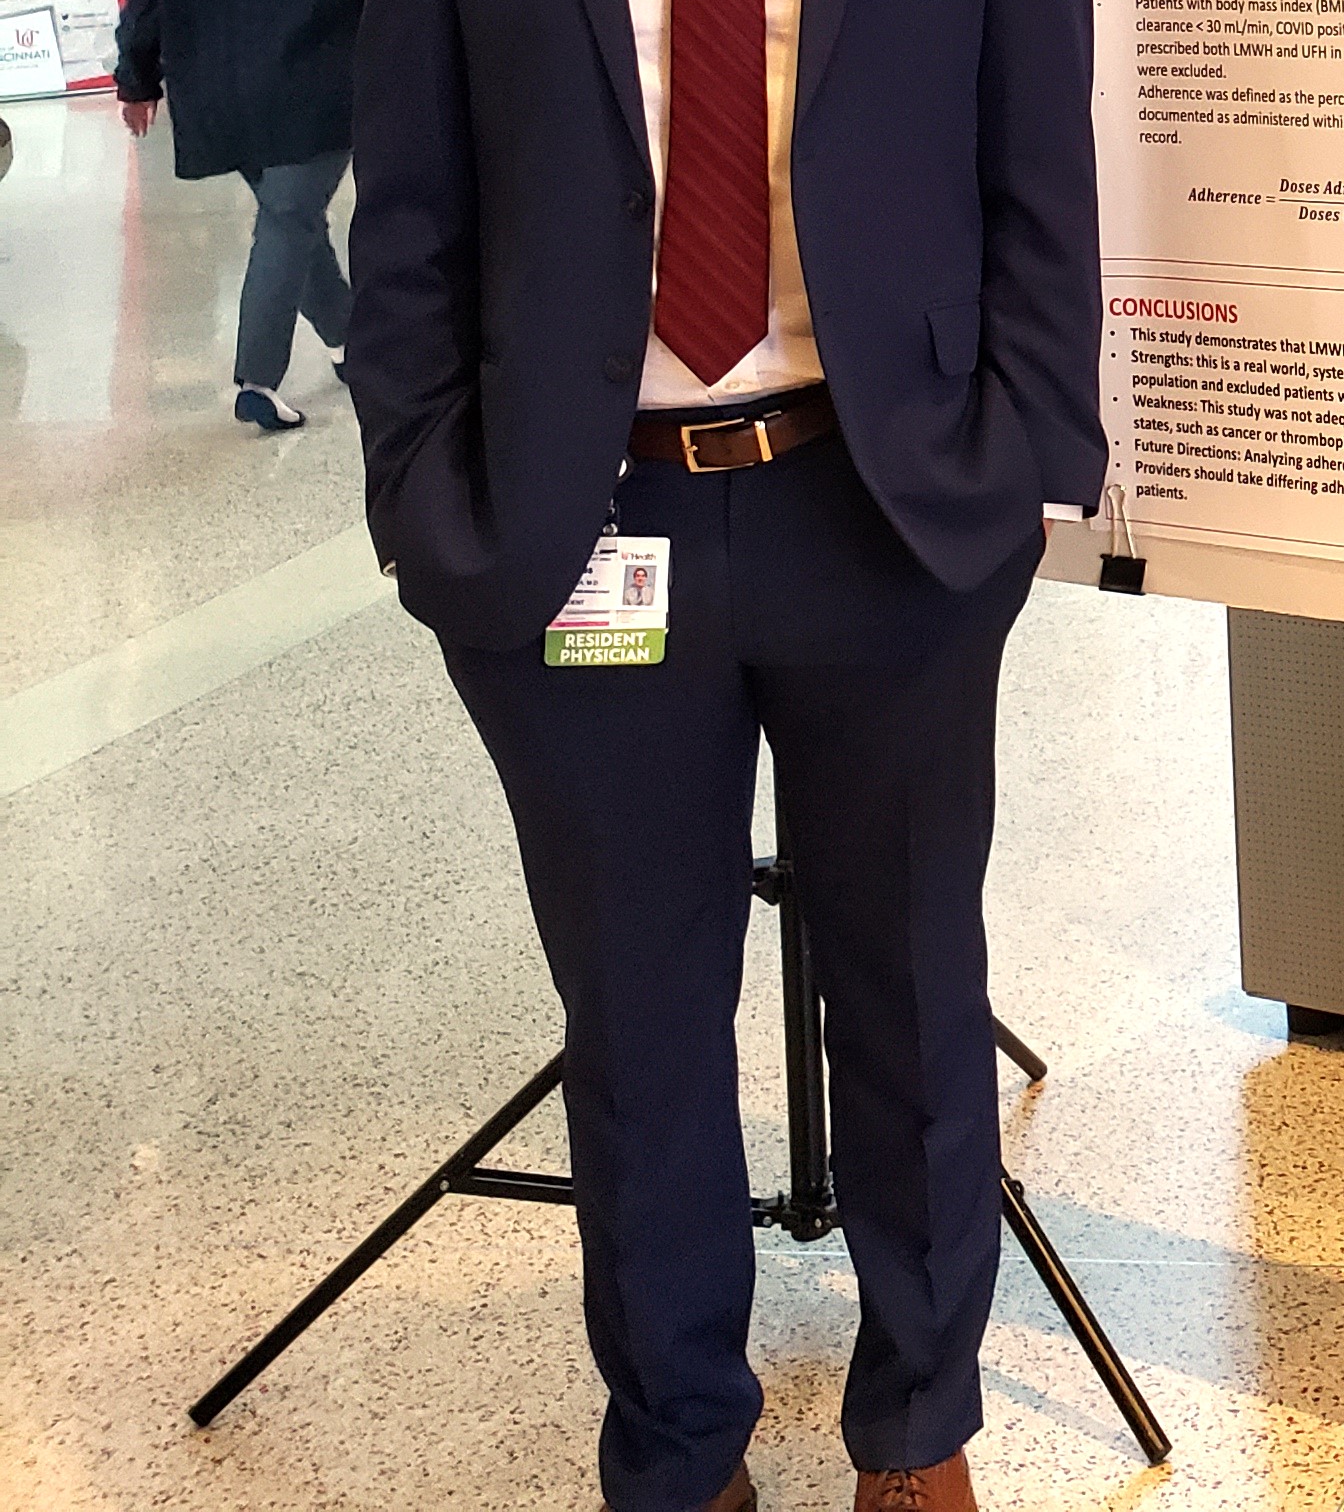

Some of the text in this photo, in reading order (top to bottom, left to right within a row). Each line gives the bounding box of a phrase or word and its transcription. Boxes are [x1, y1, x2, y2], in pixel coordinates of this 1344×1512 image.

[1188, 187, 1261, 204] Adherence
[1109, 298, 1238, 323] CONCLUSIONS
[565, 632, 647, 647] RESIDENT
[560, 647, 650, 663] PHYSICIAN
